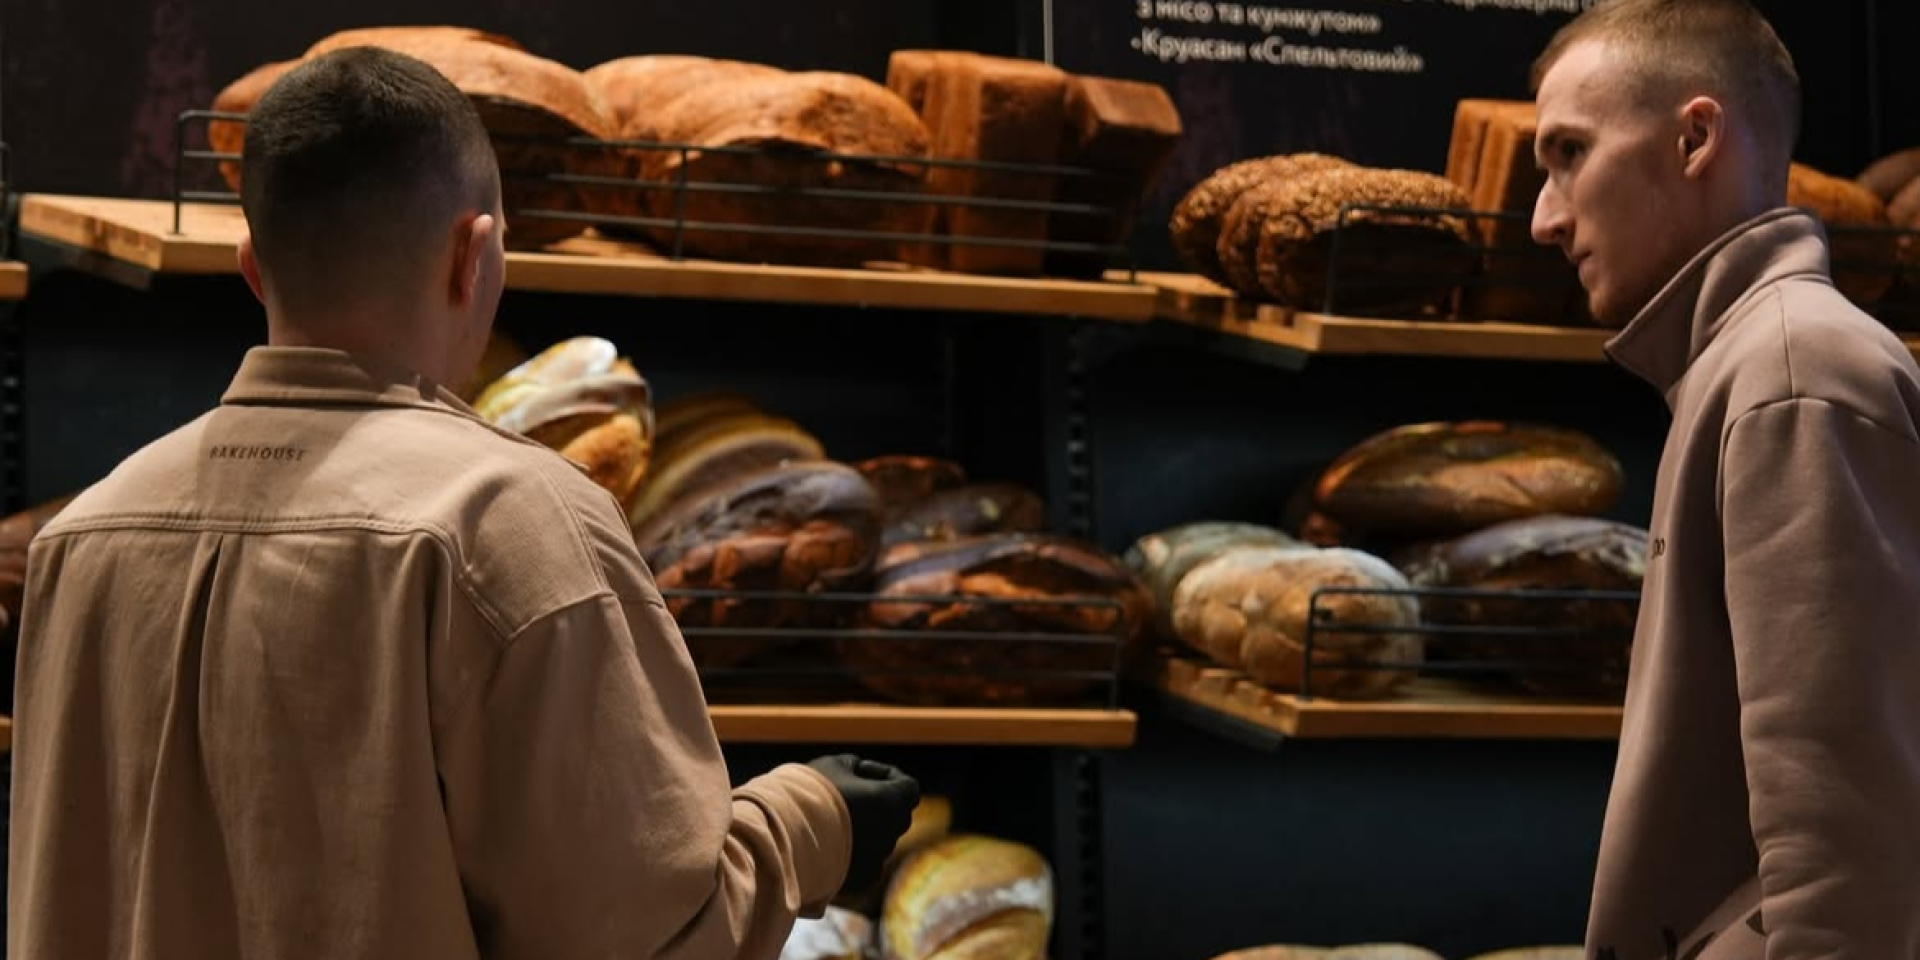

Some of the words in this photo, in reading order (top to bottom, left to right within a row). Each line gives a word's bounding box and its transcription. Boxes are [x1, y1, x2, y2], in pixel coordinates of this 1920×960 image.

[1136, 0, 1153, 19] з
[1156, 0, 1214, 23] місо
[1216, 3, 1245, 25] та
[1249, 35, 1424, 72] «Спельтовий»
[209, 446, 307, 462] BAKEHOUSE
